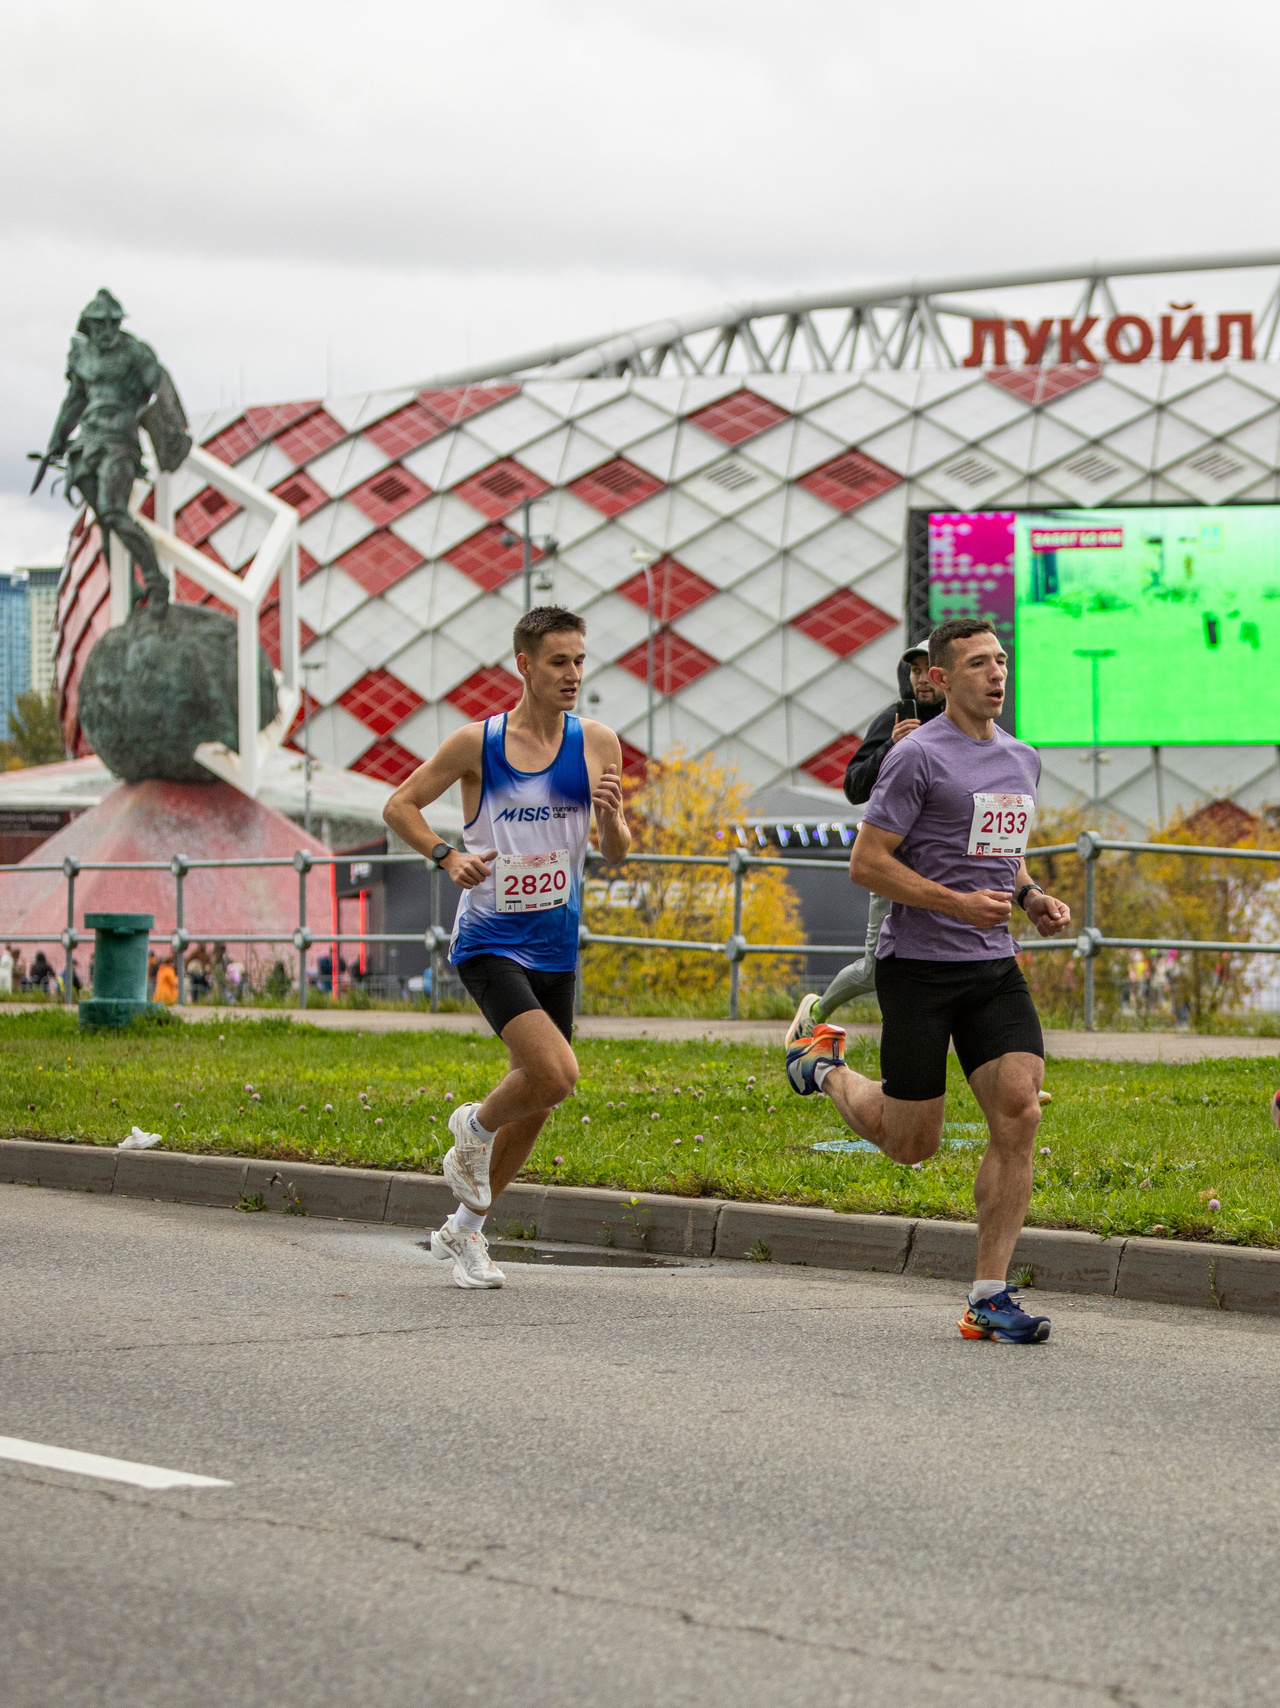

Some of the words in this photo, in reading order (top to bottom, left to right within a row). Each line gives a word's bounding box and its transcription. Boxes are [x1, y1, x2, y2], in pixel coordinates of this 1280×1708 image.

[963, 302, 1256, 368] ЛУКОЙЛ
[493, 806, 550, 823] MISIS
[981, 811, 1027, 834] 2133
[504, 870, 566, 895] 2820
